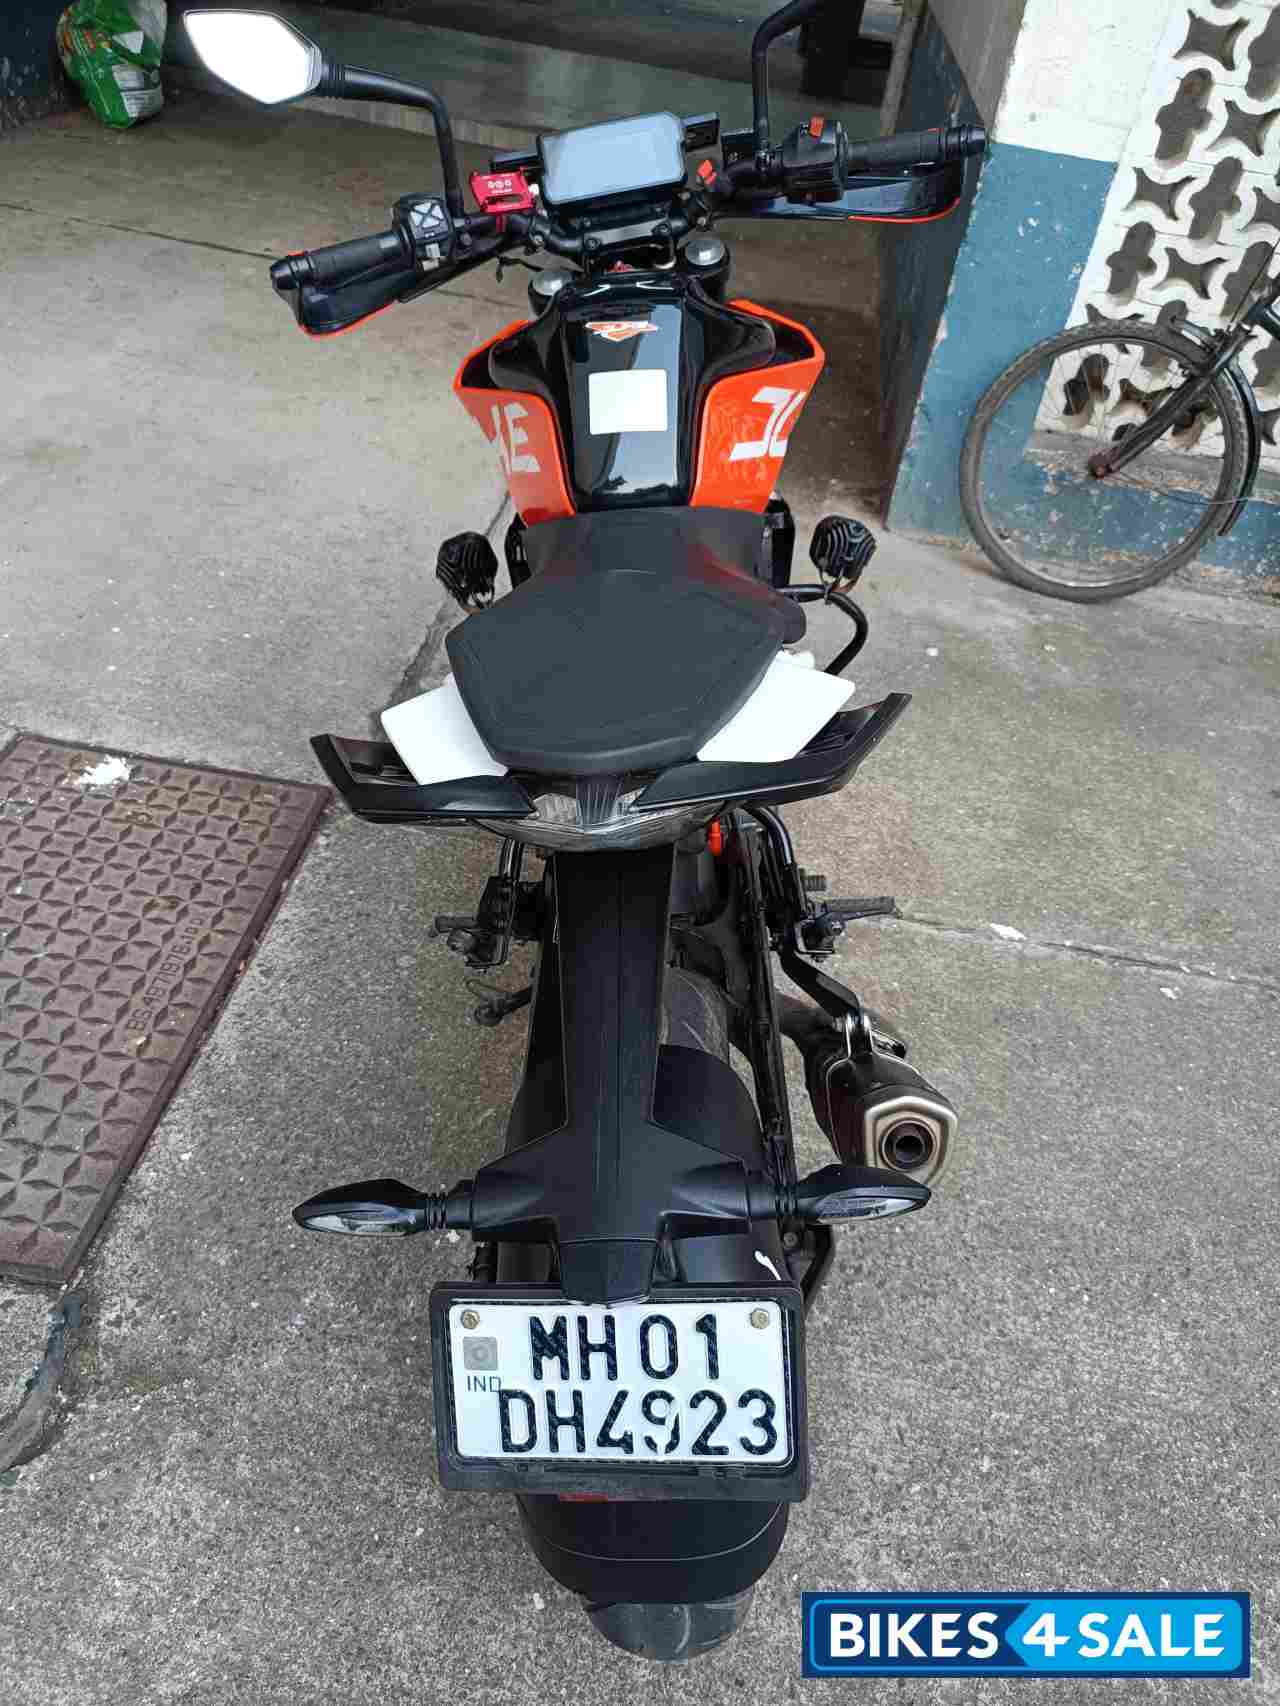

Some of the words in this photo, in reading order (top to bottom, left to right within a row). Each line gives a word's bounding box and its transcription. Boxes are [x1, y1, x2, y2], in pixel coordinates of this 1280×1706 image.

[529, 1315, 618, 1381] MH
[639, 1313, 720, 1380] 01
[465, 1375, 502, 1393] IND
[499, 1388, 778, 1456] DH4923
